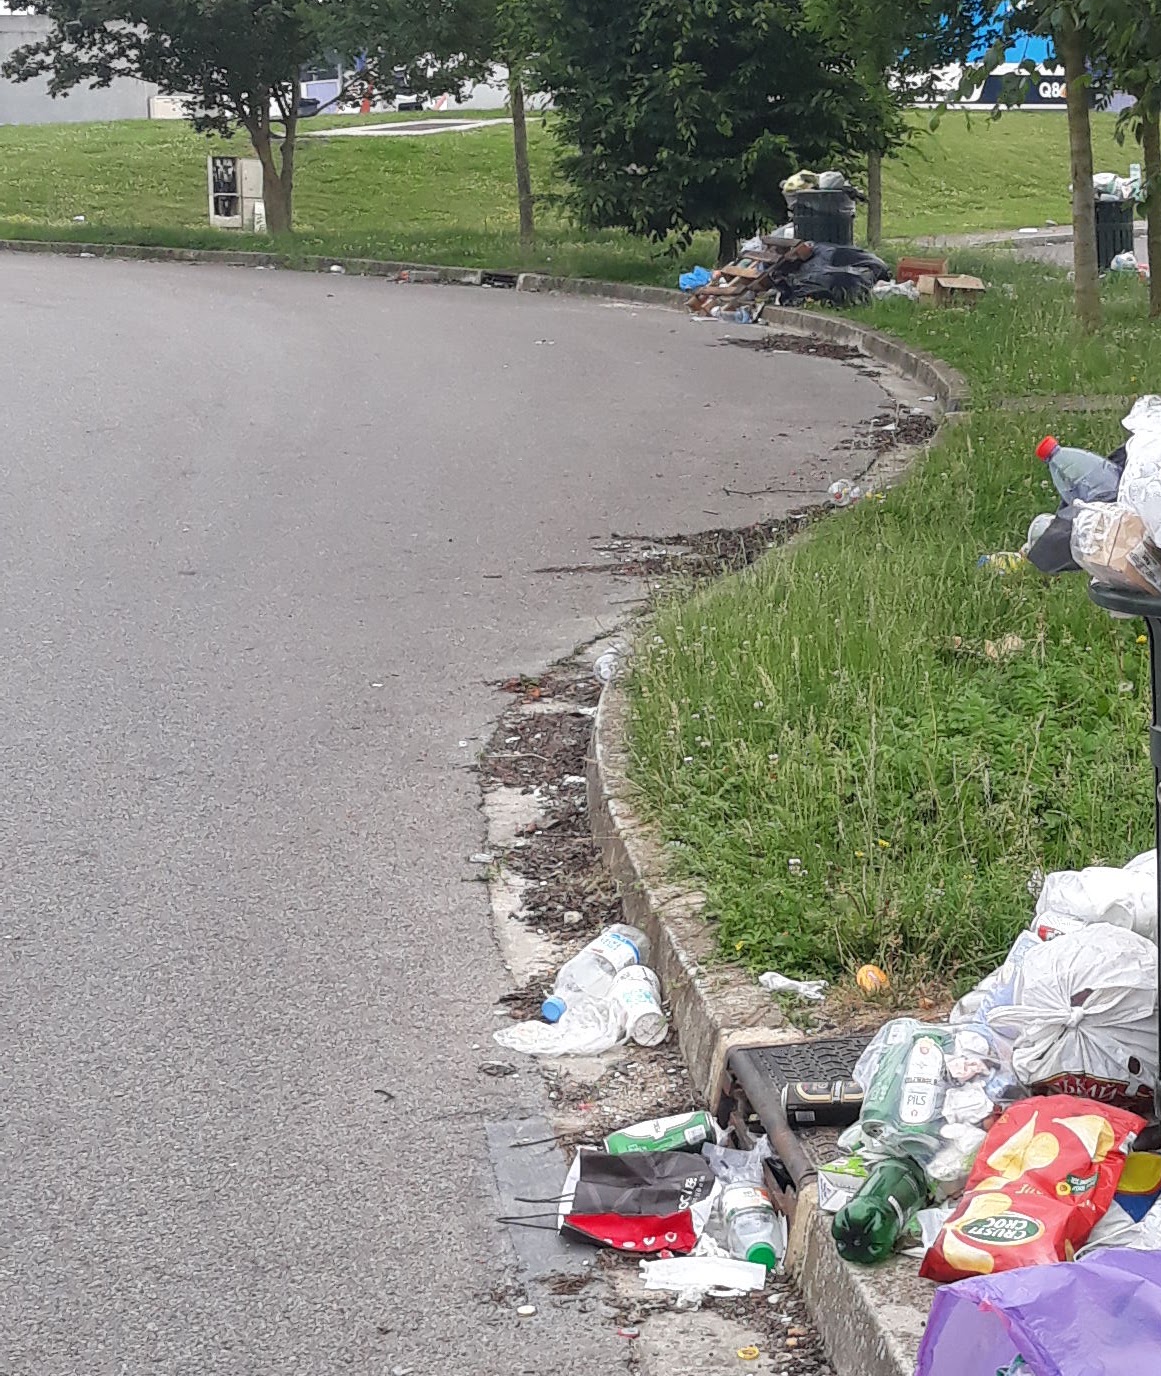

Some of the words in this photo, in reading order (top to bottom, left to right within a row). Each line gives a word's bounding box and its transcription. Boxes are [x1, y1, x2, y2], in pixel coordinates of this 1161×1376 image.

[1039, 81, 1061, 99] Q8
[981, 1217, 1029, 1229] CROC
[968, 1226, 1028, 1240] CRUSTI
